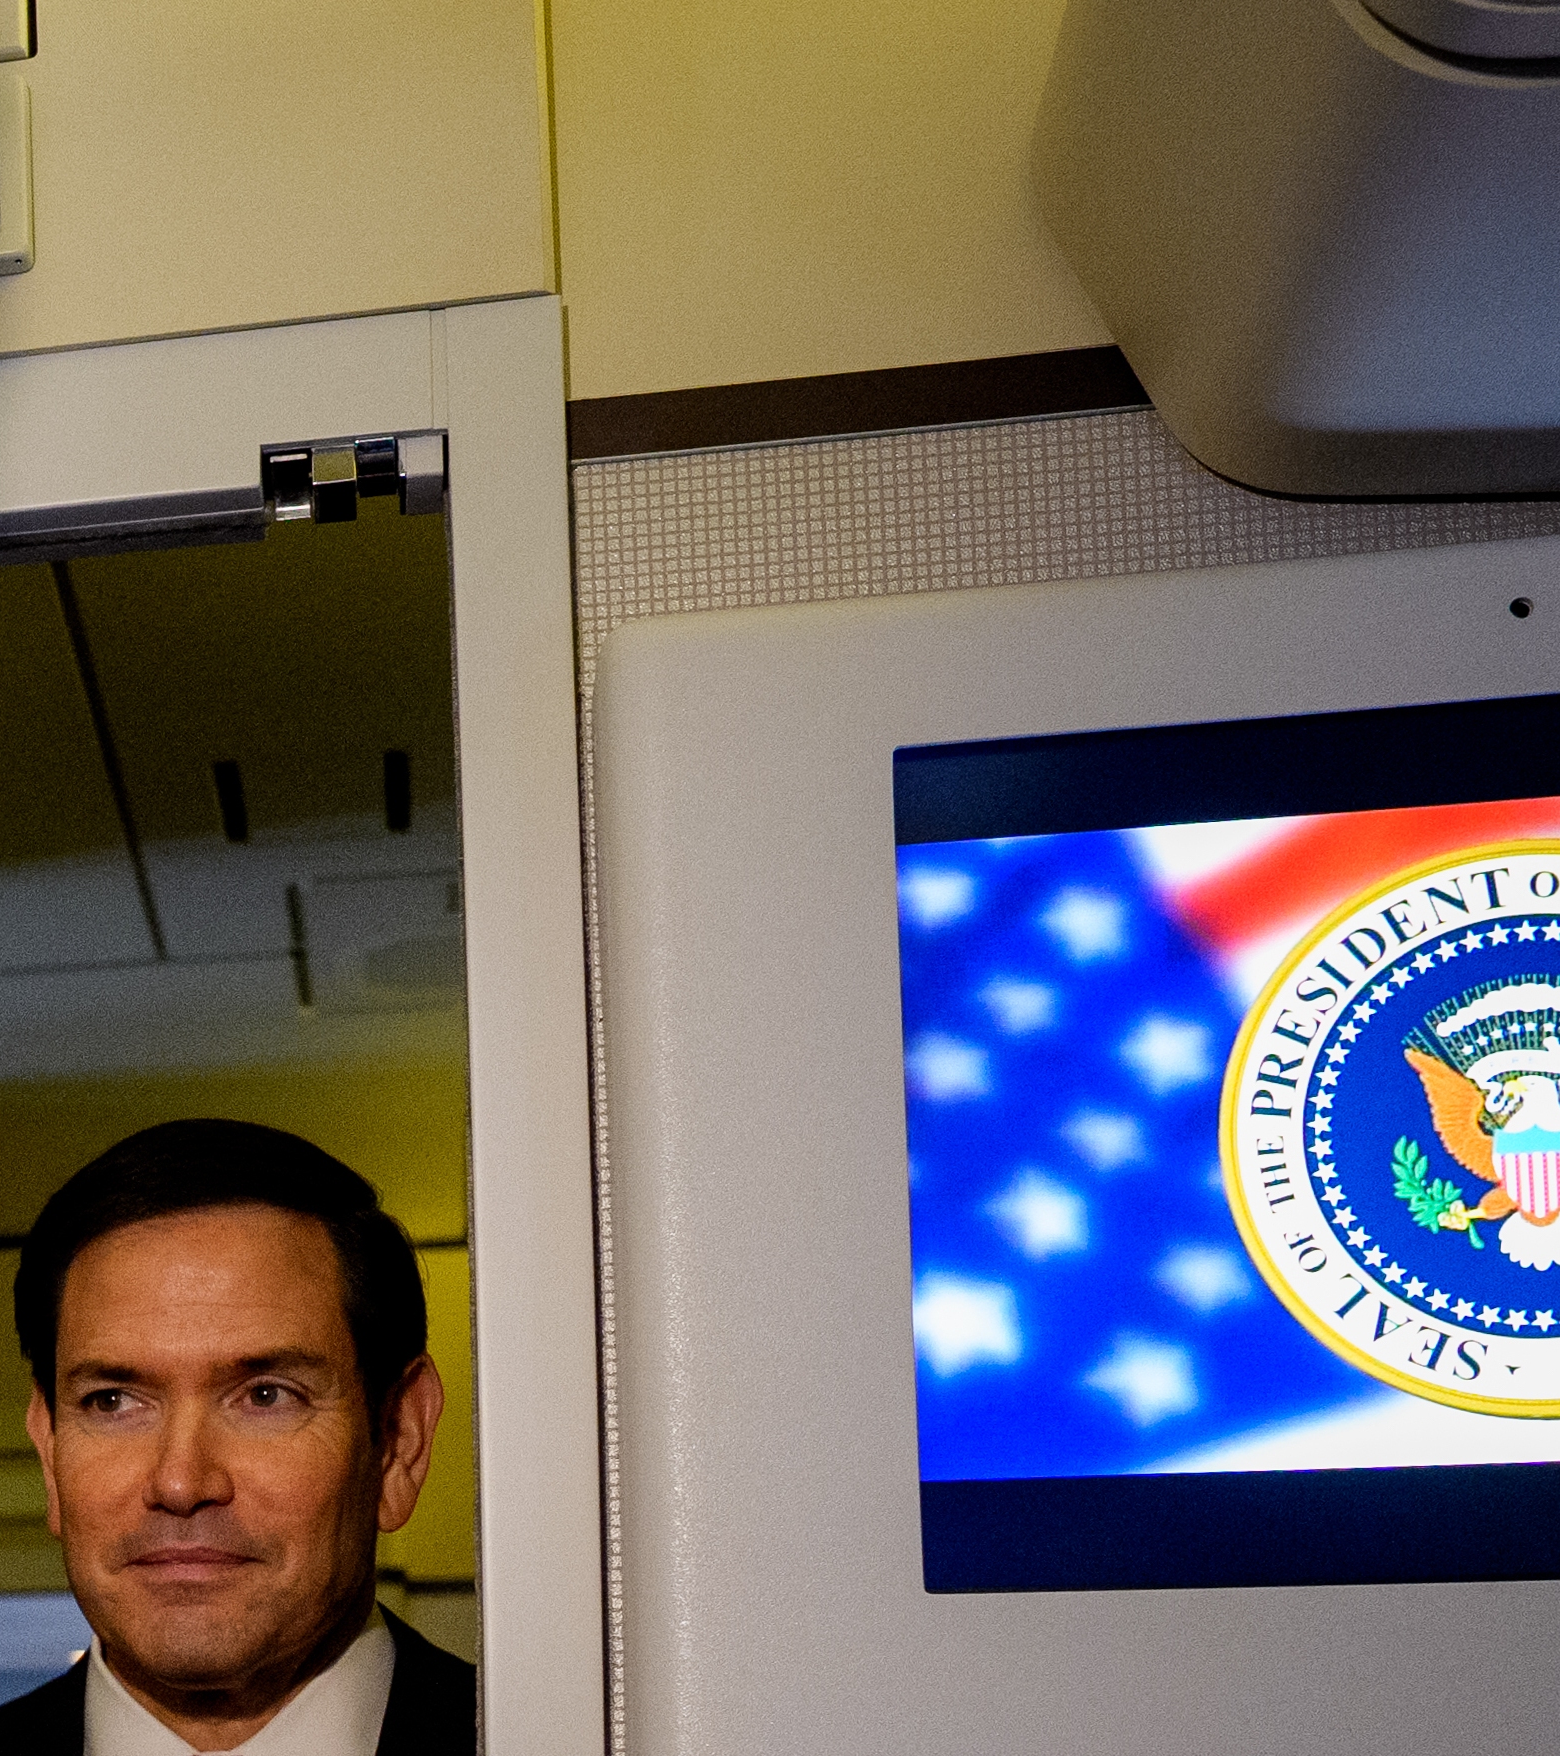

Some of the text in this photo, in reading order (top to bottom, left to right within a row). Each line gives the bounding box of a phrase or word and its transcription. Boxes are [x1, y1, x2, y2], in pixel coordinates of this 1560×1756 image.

[1250, 867, 1510, 1118] PRESIDENT
[1256, 1135, 1295, 1214] THE
[1283, 1232, 1327, 1273] OF
[1334, 1273, 1488, 1381] SEAL
